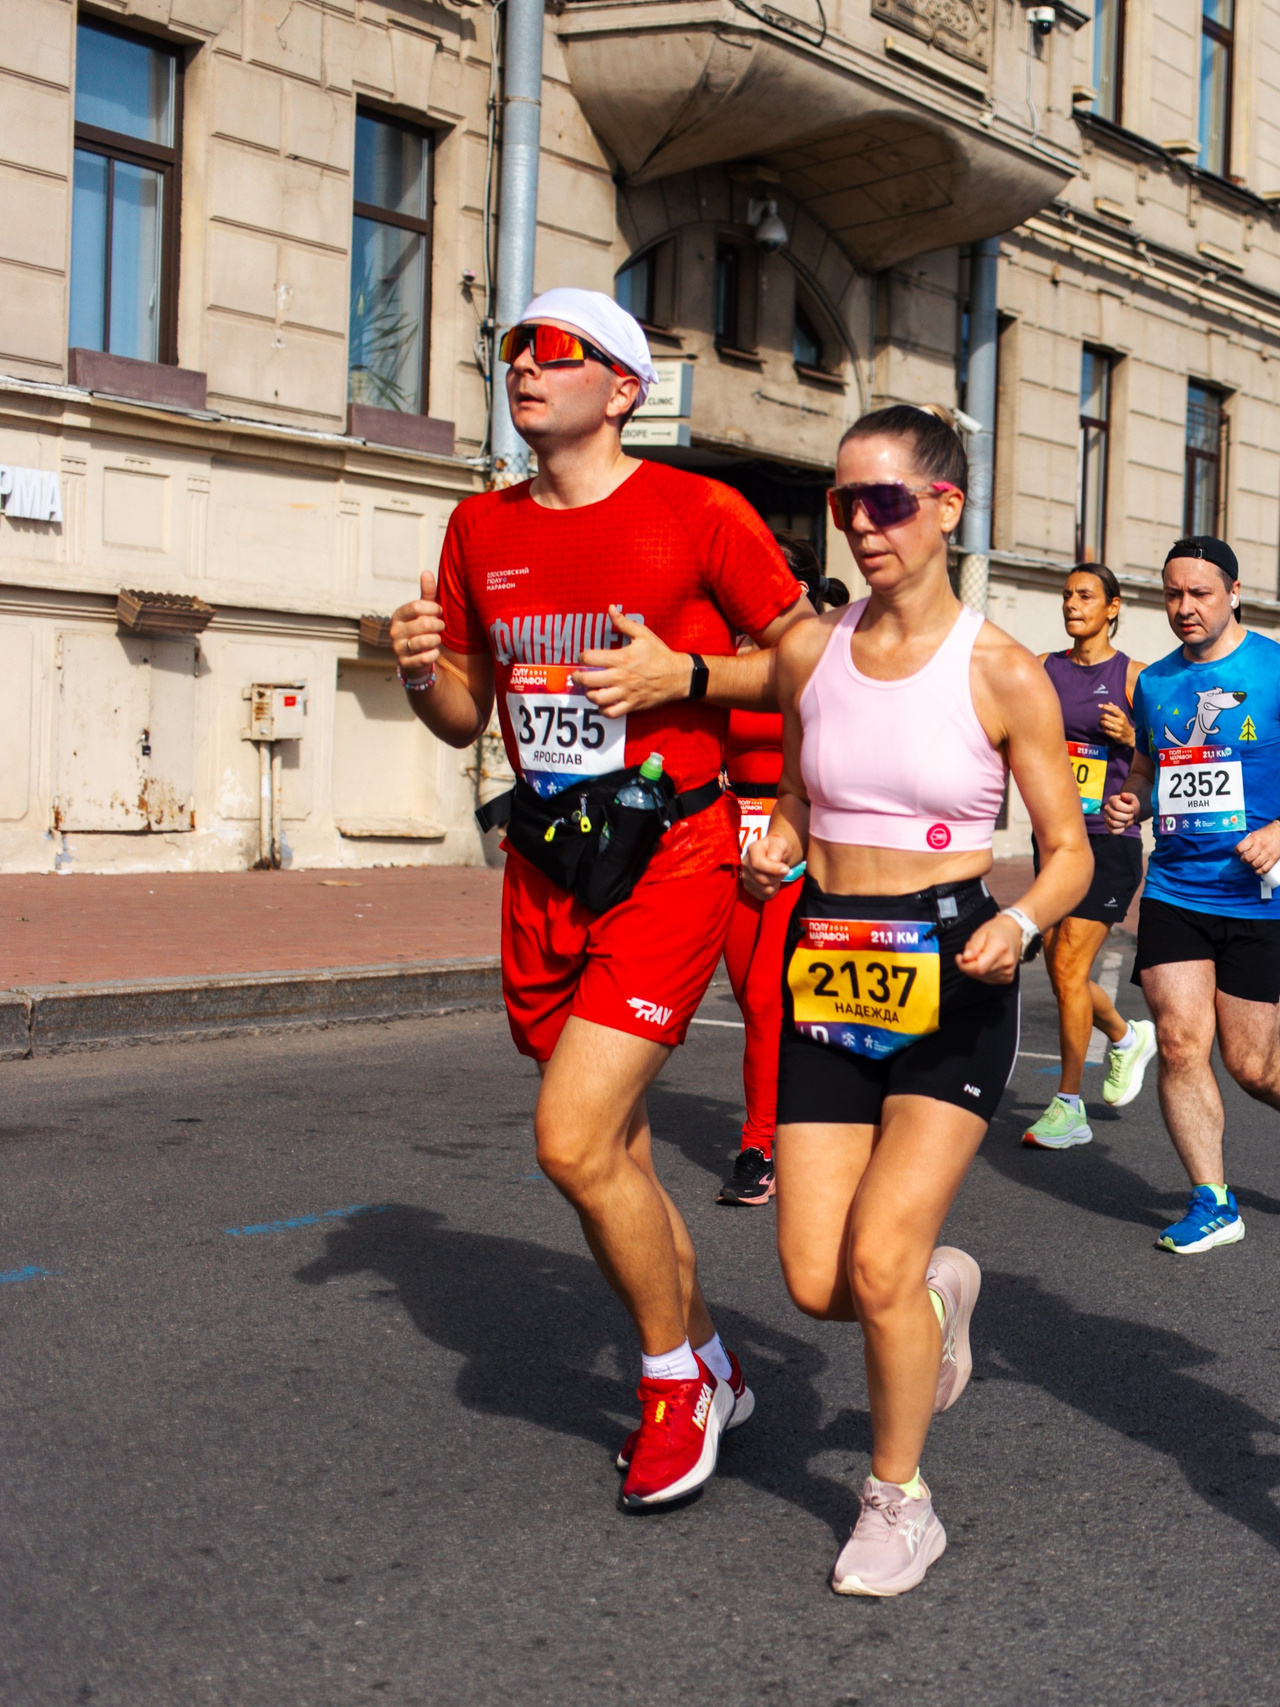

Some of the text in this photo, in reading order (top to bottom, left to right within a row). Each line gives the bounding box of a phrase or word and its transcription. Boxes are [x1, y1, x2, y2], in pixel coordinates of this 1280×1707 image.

[487, 582, 515, 591] МАРАФОН
[519, 704, 605, 750] 3755
[533, 750, 583, 765] ЯРОСЛАВ
[1203, 750, 1215, 759] 21,1
[1169, 770, 1231, 798] 2352
[1188, 800, 1209, 808] ИВАН
[739, 827, 762, 849] 71
[809, 922, 829, 931] ПОЛУ
[809, 931, 850, 941] МАРАФОН
[871, 931, 893, 945] 21,1
[808, 961, 917, 1008] 2137
[835, 1002, 900, 1023] НАДЕЖДА
[655, 1401, 666, 1423] HOKA
[692, 1382, 713, 1432] HOKA
